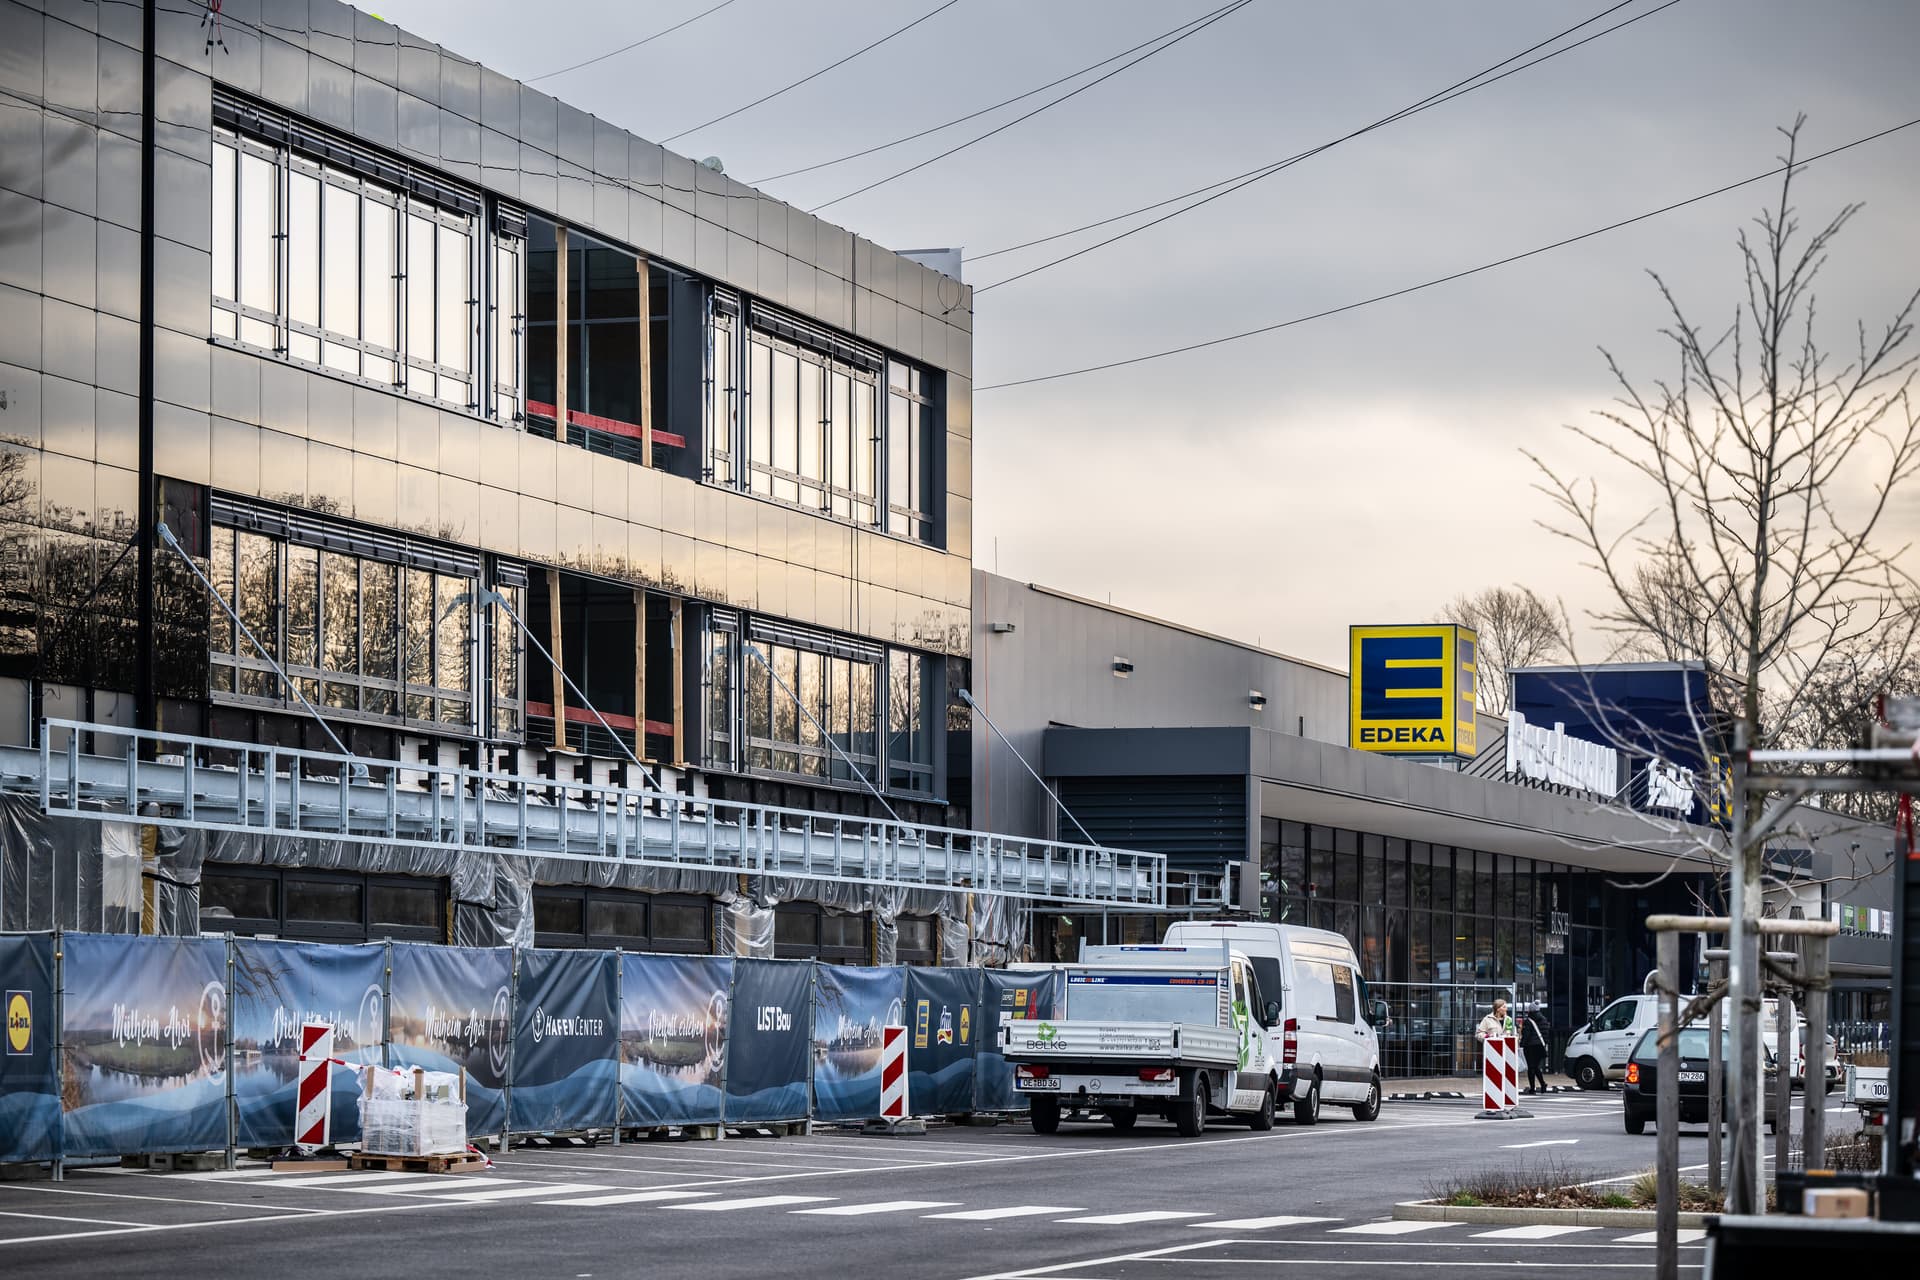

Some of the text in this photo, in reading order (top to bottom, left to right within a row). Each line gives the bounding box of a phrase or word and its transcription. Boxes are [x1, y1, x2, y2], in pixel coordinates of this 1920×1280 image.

[1360, 727, 1445, 743] EDEKA
[112, 1003, 192, 1051] Mülheim Ahoi
[272, 1005, 316, 1052] Vielf
[757, 1006, 792, 1031] LIST Bau
[1873, 1084, 1887, 1096] 100
